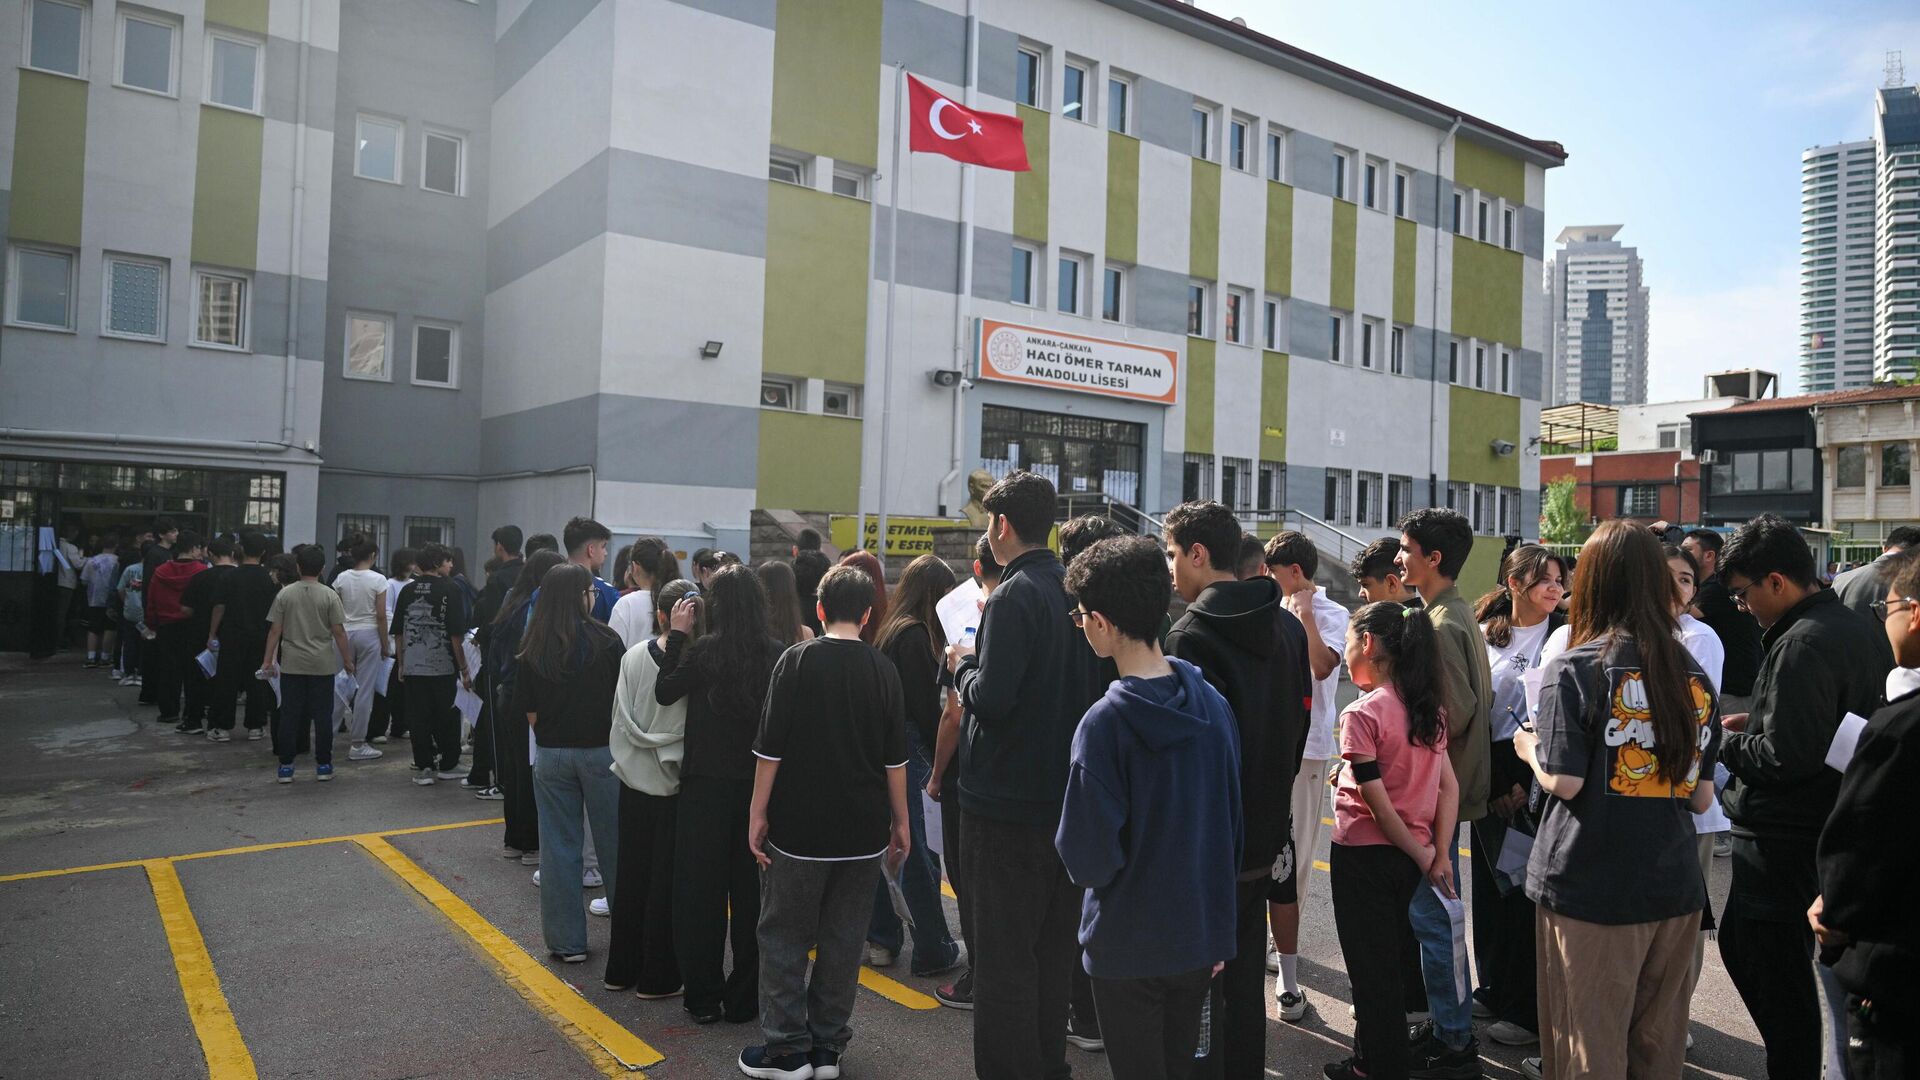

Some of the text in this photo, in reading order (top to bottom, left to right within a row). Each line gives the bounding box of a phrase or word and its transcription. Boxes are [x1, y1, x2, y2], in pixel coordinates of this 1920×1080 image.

[1026, 349, 1162, 379] HACI ÖMER TARMAN
[1026, 366, 1129, 389] ANADOLU LİSESİ
